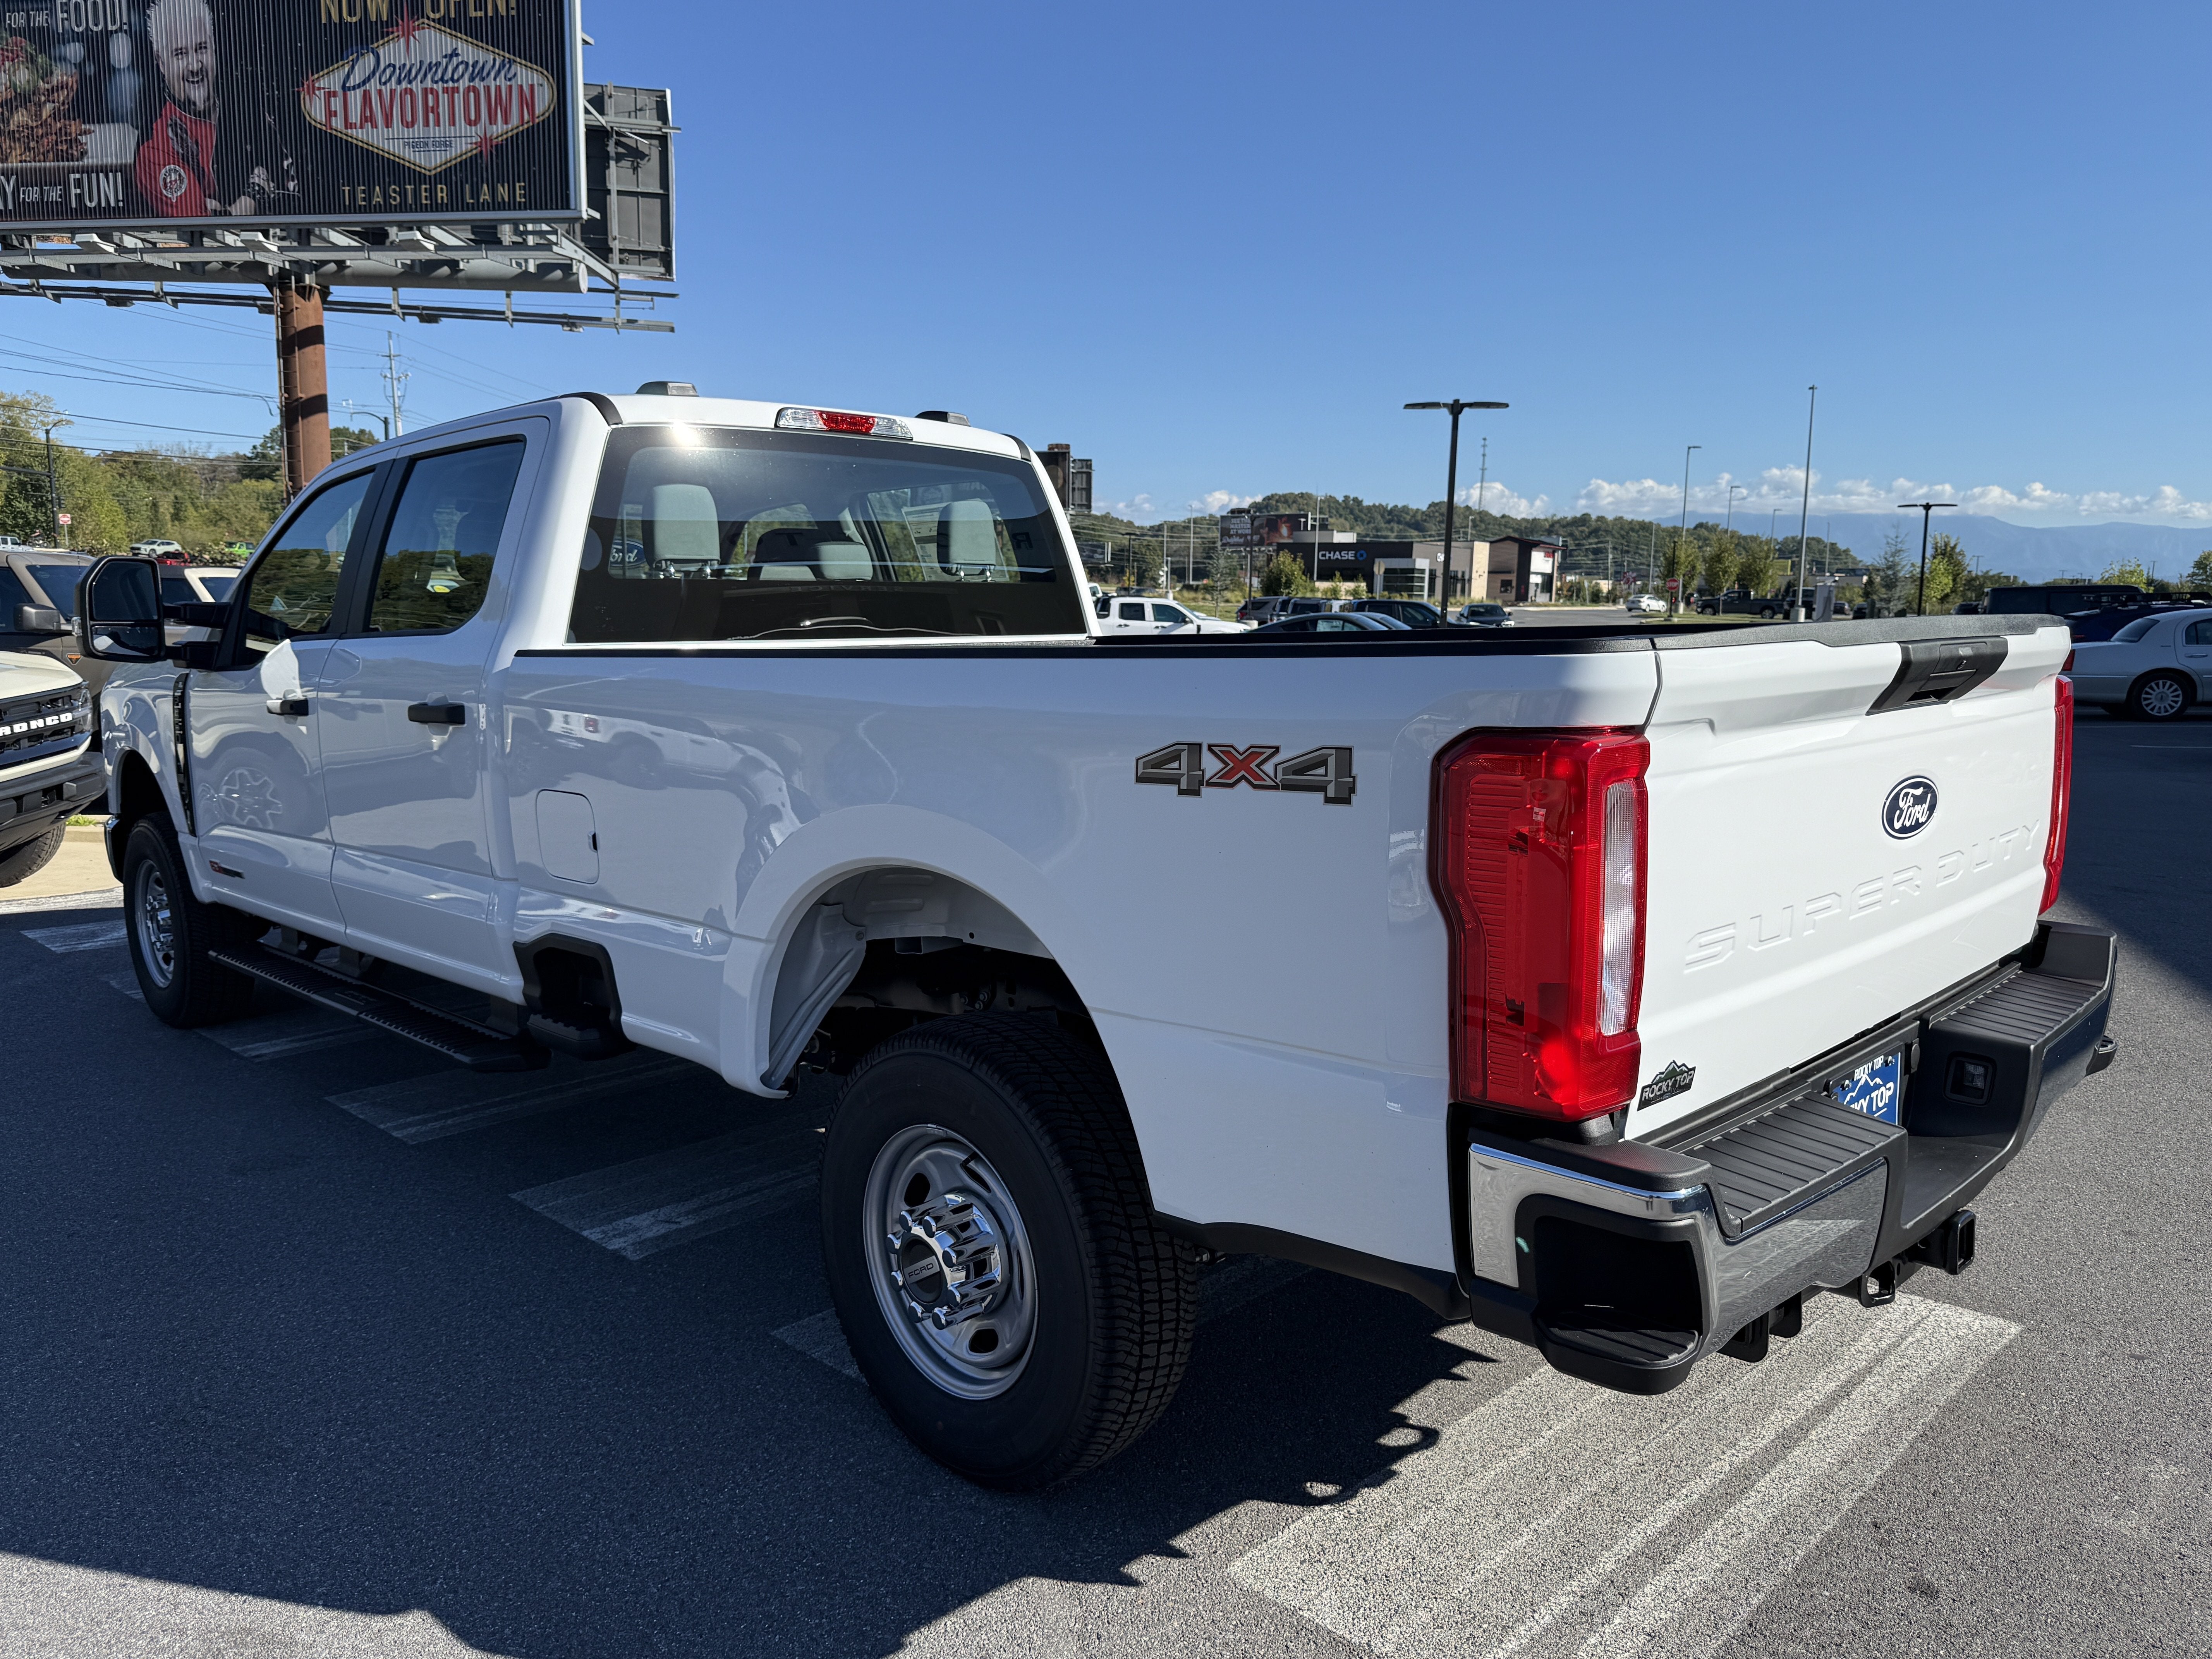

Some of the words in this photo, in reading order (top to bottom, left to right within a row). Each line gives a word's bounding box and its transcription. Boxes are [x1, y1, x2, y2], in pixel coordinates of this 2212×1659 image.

[6, 12, 25, 27] FOR
[29, 10, 48, 27] THE
[58, 0, 128, 33] FOOD!
[321, 0, 387, 23] NOW
[342, 45, 517, 92] Downtown
[323, 84, 537, 131] FLAVORTOWN
[404, 141, 429, 149] PIGEON
[0, 175, 16, 210] Y
[20, 187, 39, 202] FOR
[43, 186, 62, 202] THE
[69, 172, 123, 208] FUN!
[342, 184, 447, 205] TEASTER
[465, 182, 526, 203] LANE
[1319, 551, 1355, 560] CHASE
[1134, 741, 1358, 806] 4X4
[1894, 787, 1931, 830] Ford
[1683, 865, 1922, 974] SUPER
[1936, 819, 2040, 887] DUTY
[1854, 1061, 1873, 1081] ROCKY
[1873, 1055, 1884, 1070] TOP
[1642, 1078, 1675, 1101] ROCKY
[1676, 1070, 1694, 1088] TOP
[1871, 1082, 1894, 1111] TOP
[908, 1263, 934, 1278] FORD
